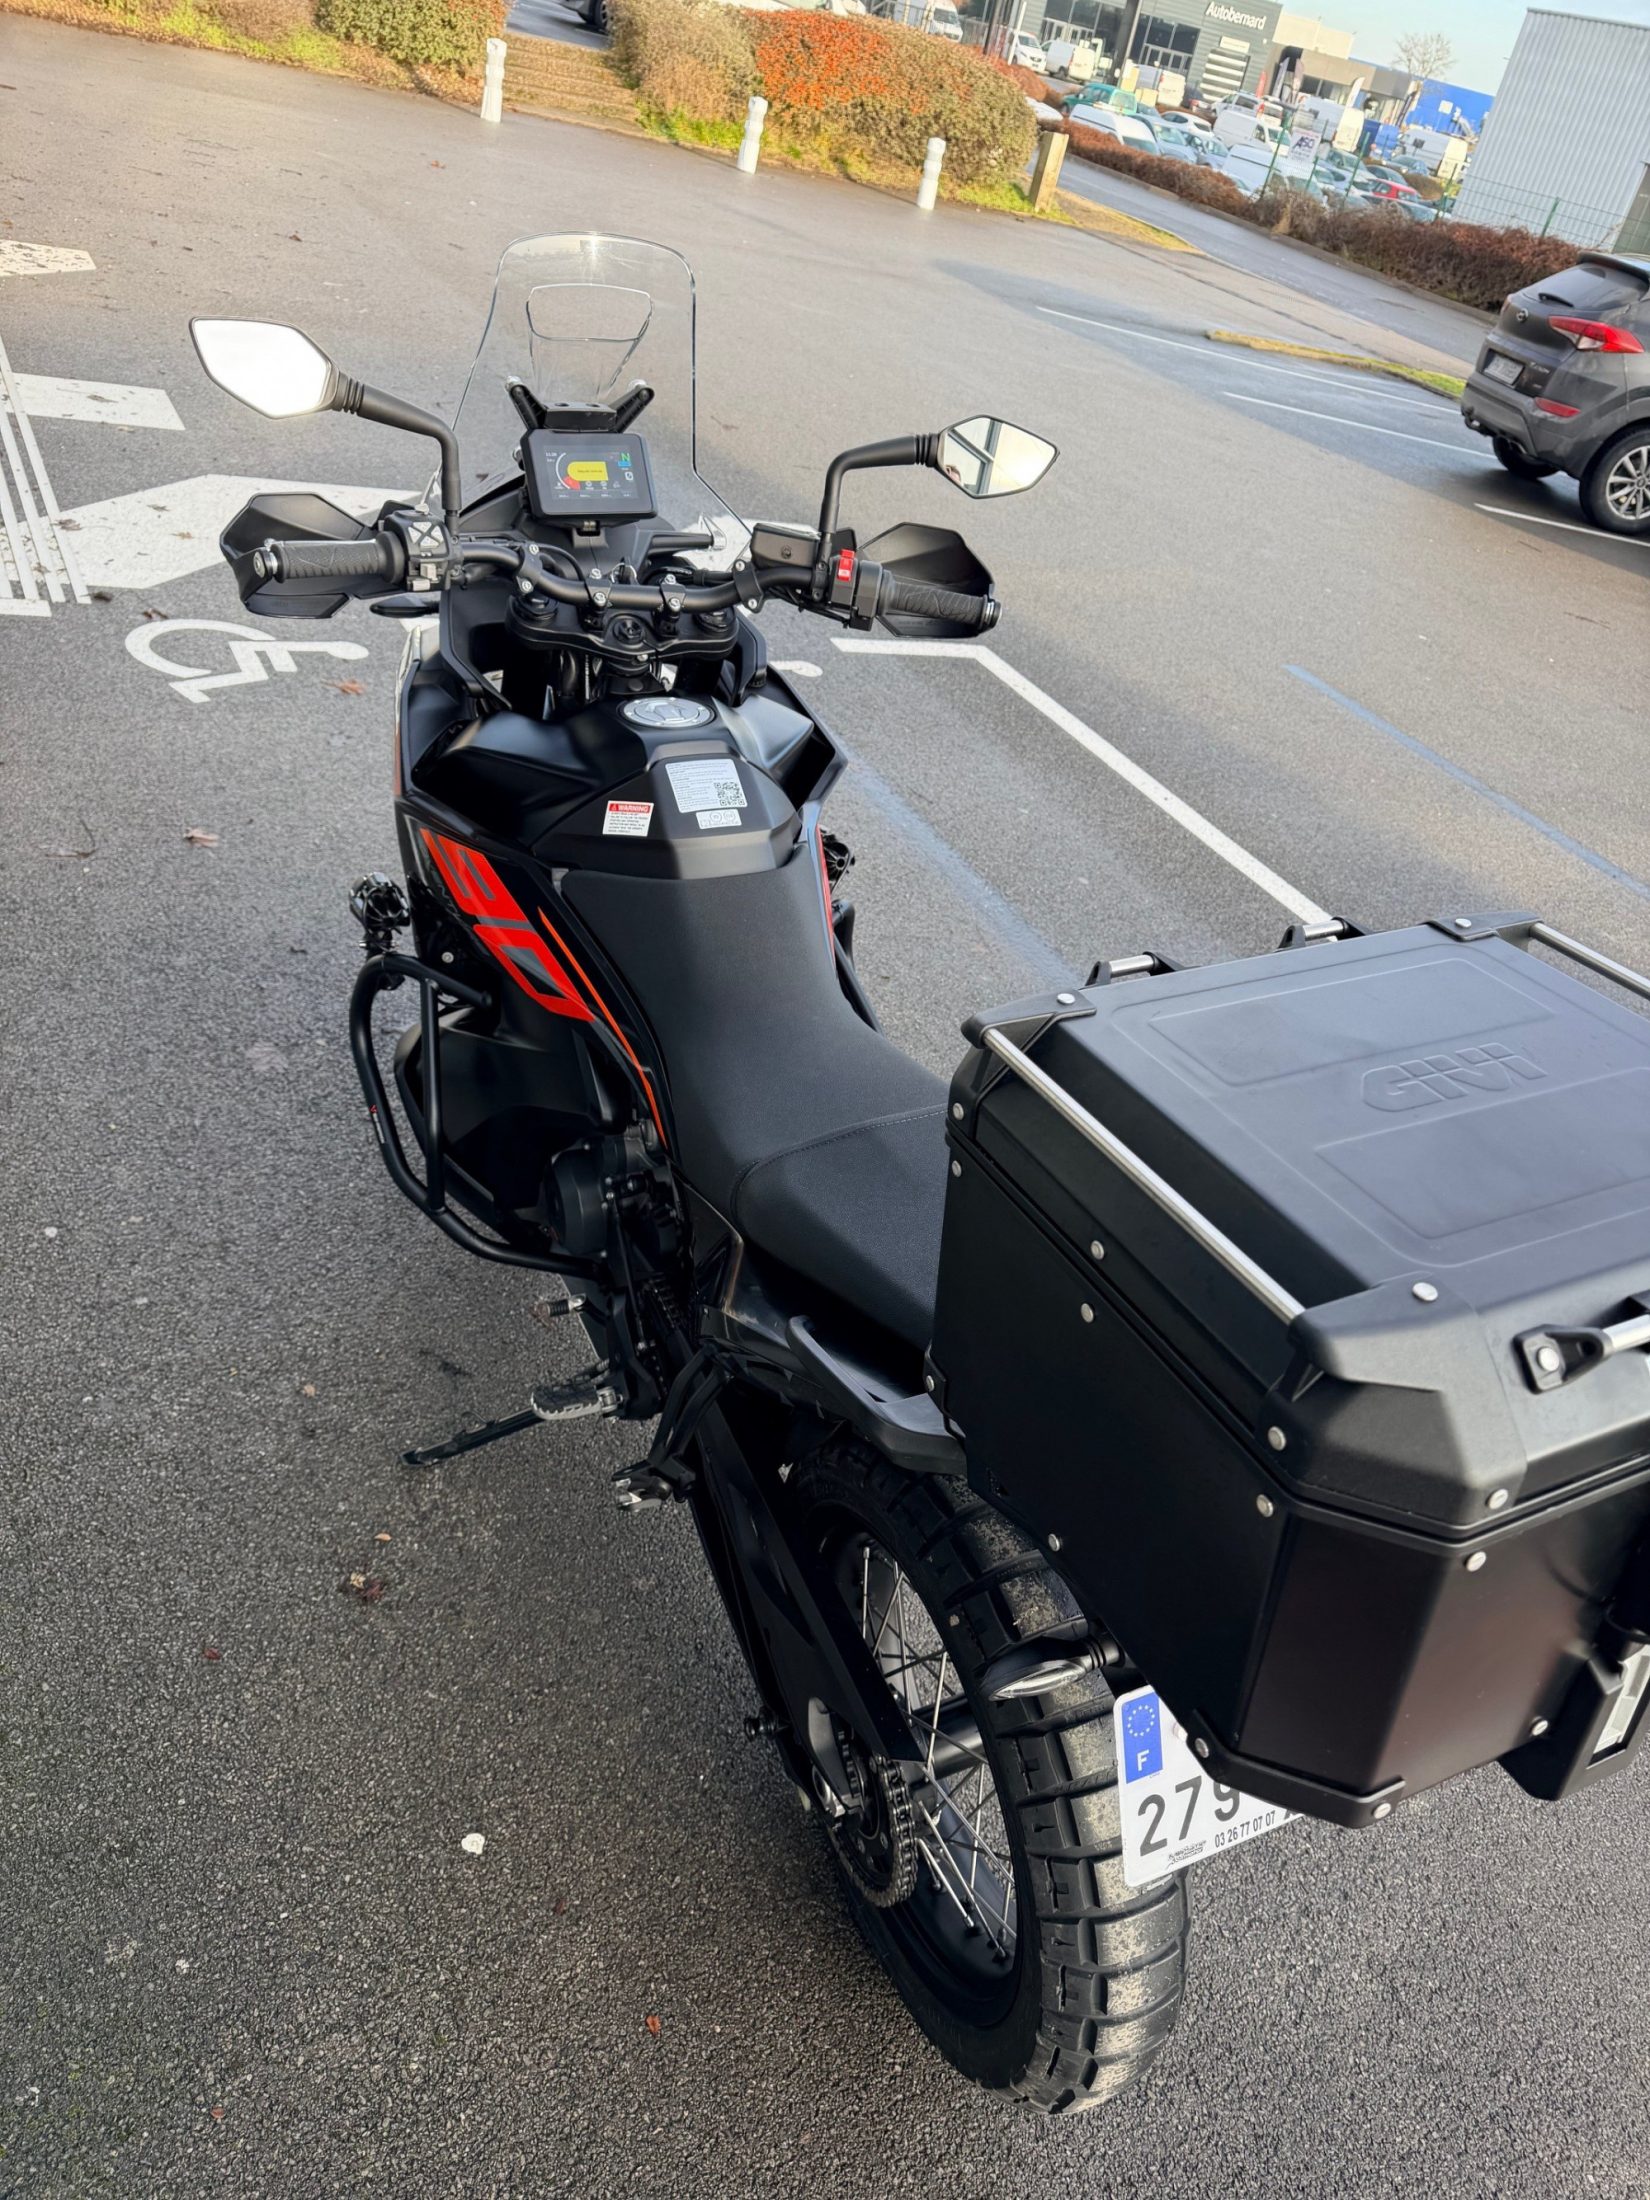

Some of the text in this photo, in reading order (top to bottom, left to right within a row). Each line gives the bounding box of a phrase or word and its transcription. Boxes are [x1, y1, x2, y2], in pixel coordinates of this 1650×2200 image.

[1205, 1, 1267, 30] Autobernard
[621, 452, 631, 461] N
[618, 804, 649, 813] WARNING
[1361, 1042, 1548, 1112] GIVI
[1137, 1749, 1149, 1771] F
[1138, 1775, 1240, 1857] 279
[1214, 1832, 1226, 1849] 03
[1227, 1826, 1239, 1844] 26
[1240, 1821, 1251, 1838] 77
[1252, 1815, 1263, 1832] 07
[1265, 1809, 1276, 1827] 07
